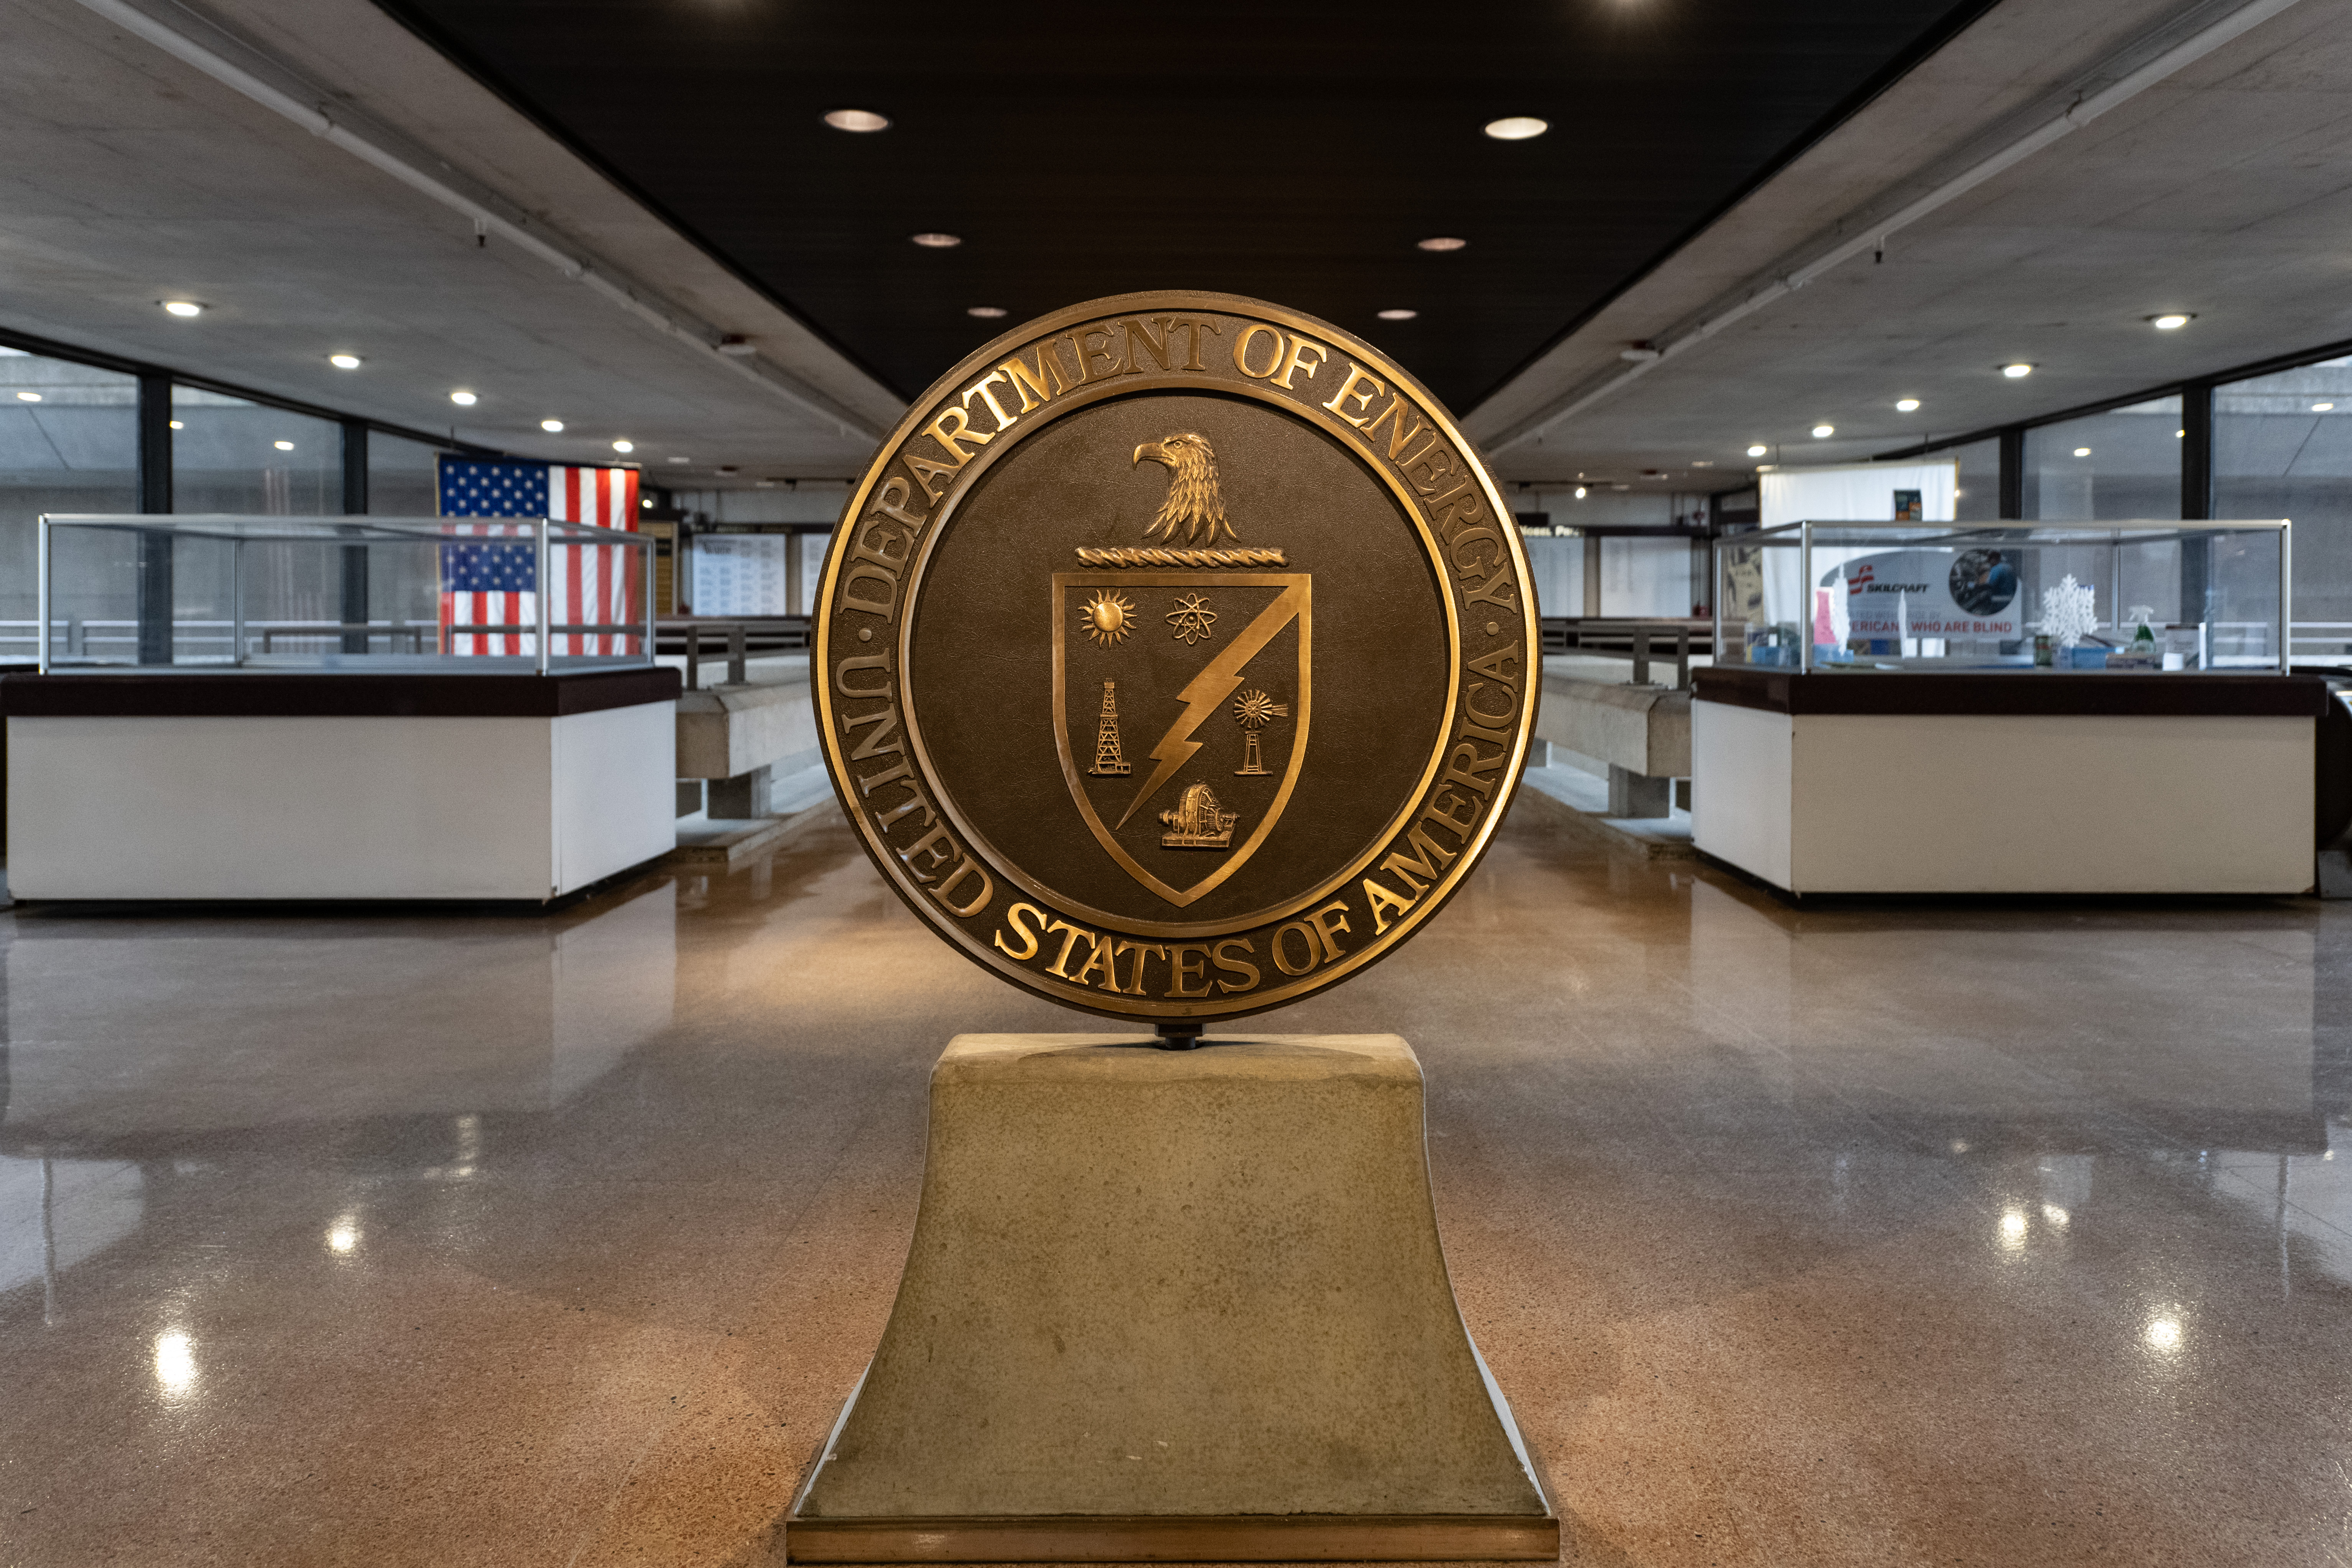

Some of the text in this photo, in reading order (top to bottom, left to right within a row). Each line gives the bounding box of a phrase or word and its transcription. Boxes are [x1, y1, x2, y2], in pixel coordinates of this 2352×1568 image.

[839, 317, 1518, 624] DEPARTMENT OF ENERGY
[1852, 620, 2012, 633] ERICAN WHO ARE BLIND
[1867, 583, 1930, 593] SKILCRAFT
[835, 640, 1519, 998] UNITED STATES OF AMERICA
